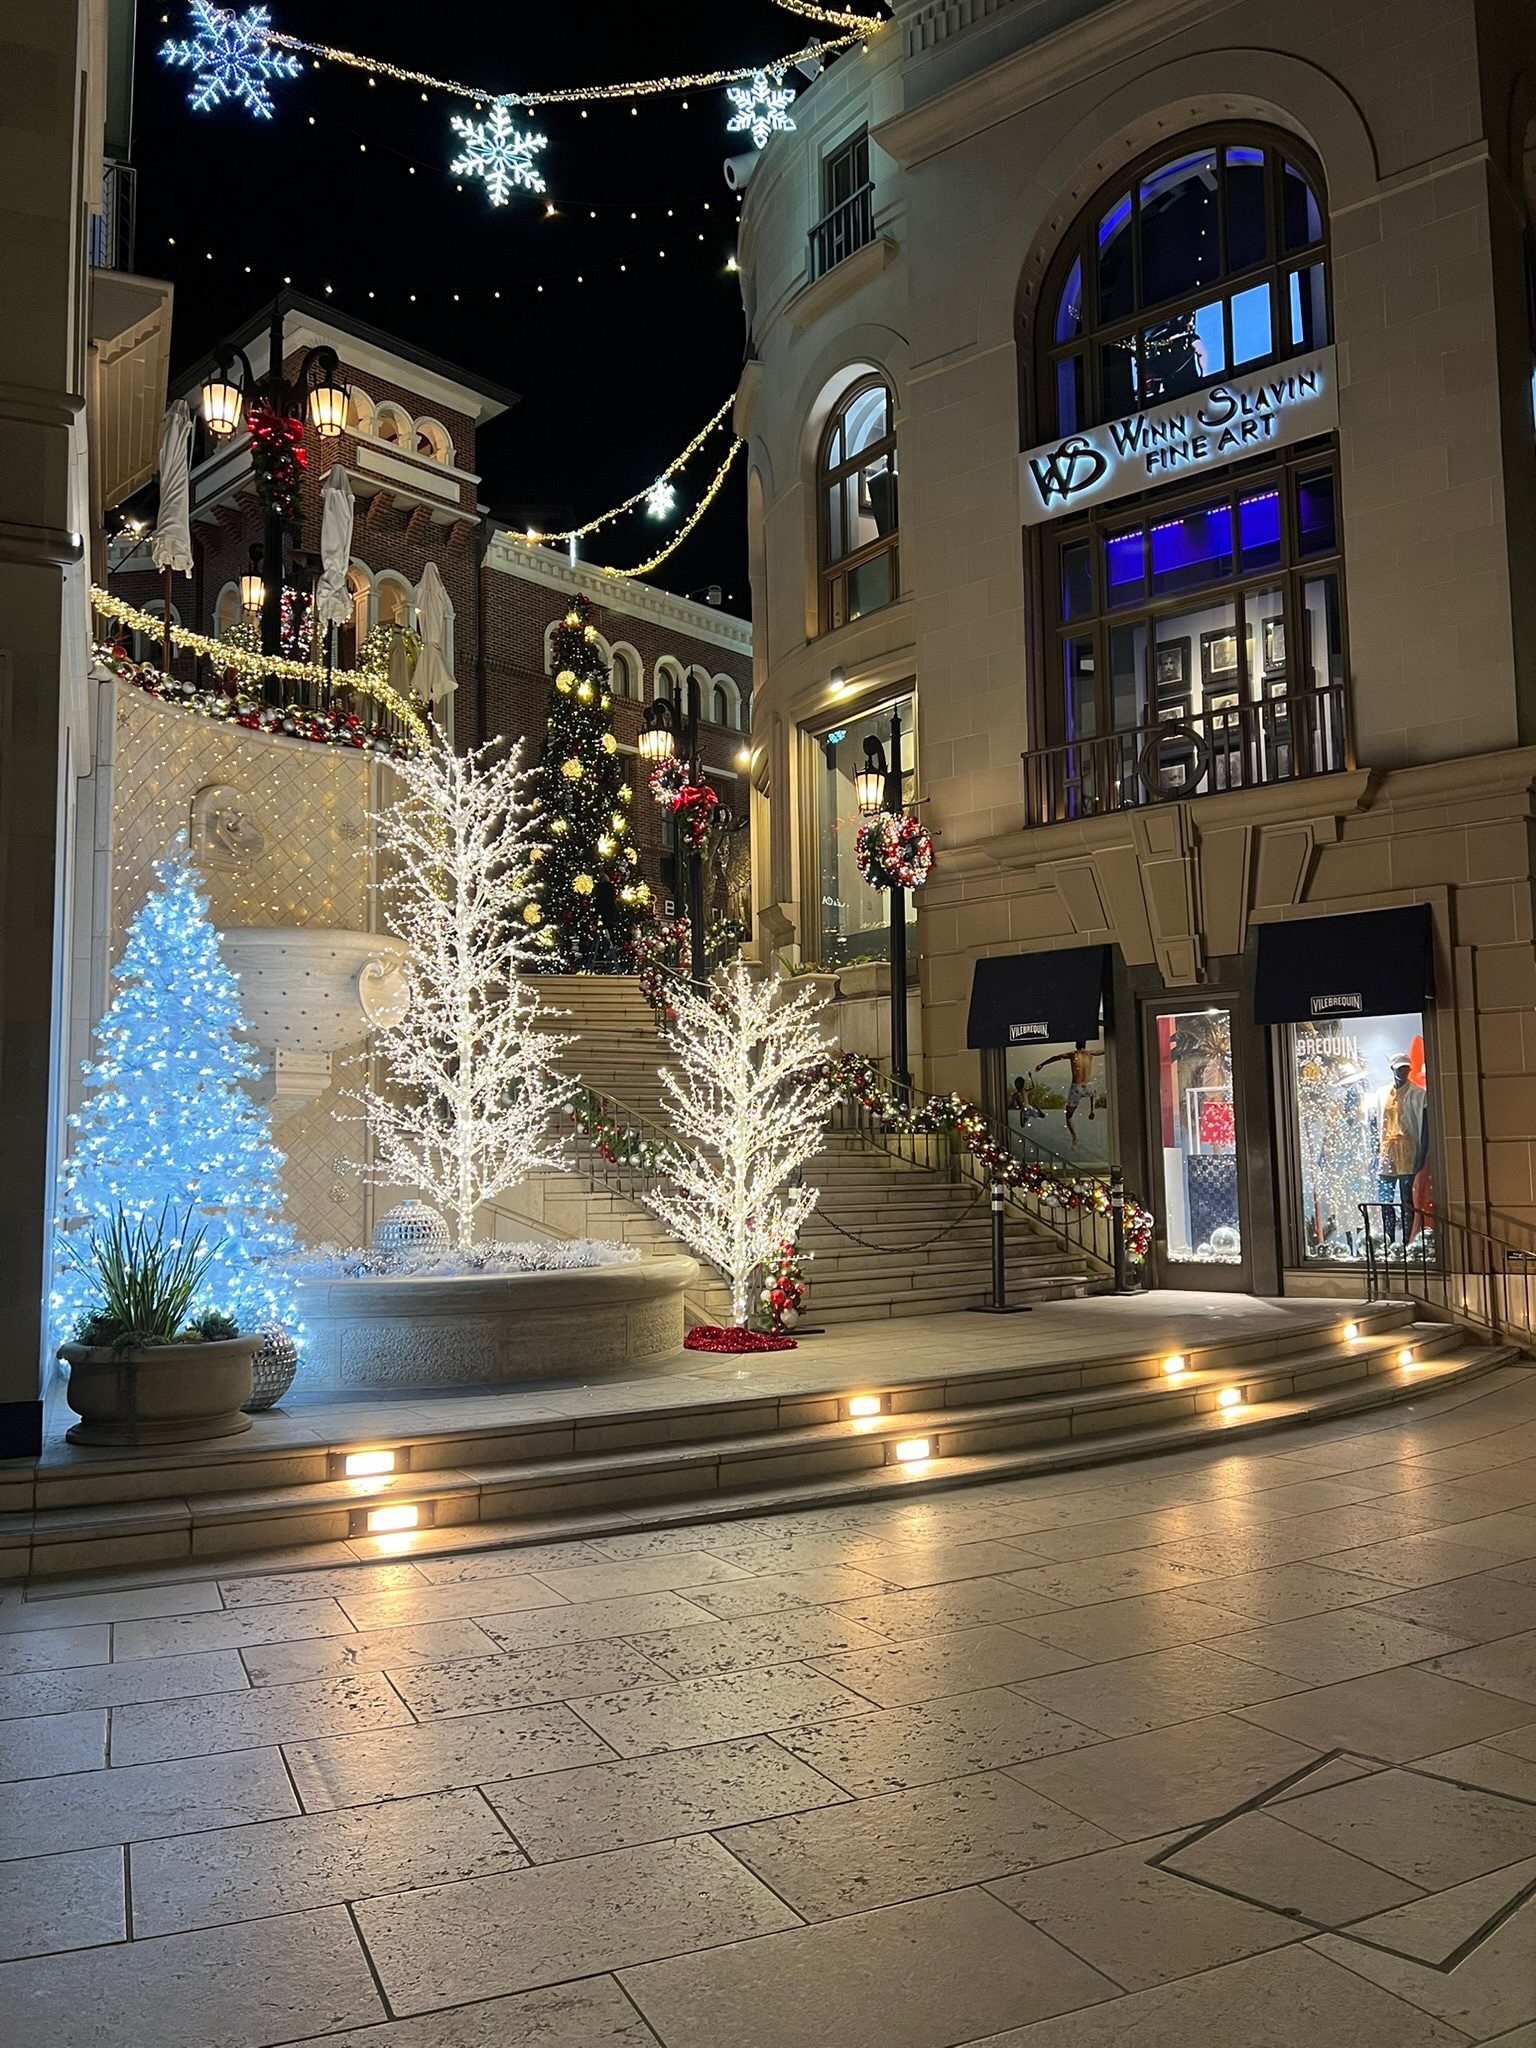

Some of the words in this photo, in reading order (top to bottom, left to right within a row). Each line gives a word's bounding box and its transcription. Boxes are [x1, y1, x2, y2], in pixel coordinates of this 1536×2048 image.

[1108, 414, 1187, 457] WINN
[1197, 370, 1318, 427] SLAVIN
[1145, 435, 1208, 474] FINE
[1217, 412, 1275, 452] ART
[1311, 995, 1360, 1013] VILEBREQUIN
[1010, 1023, 1048, 1040] VILEBREQUIN
